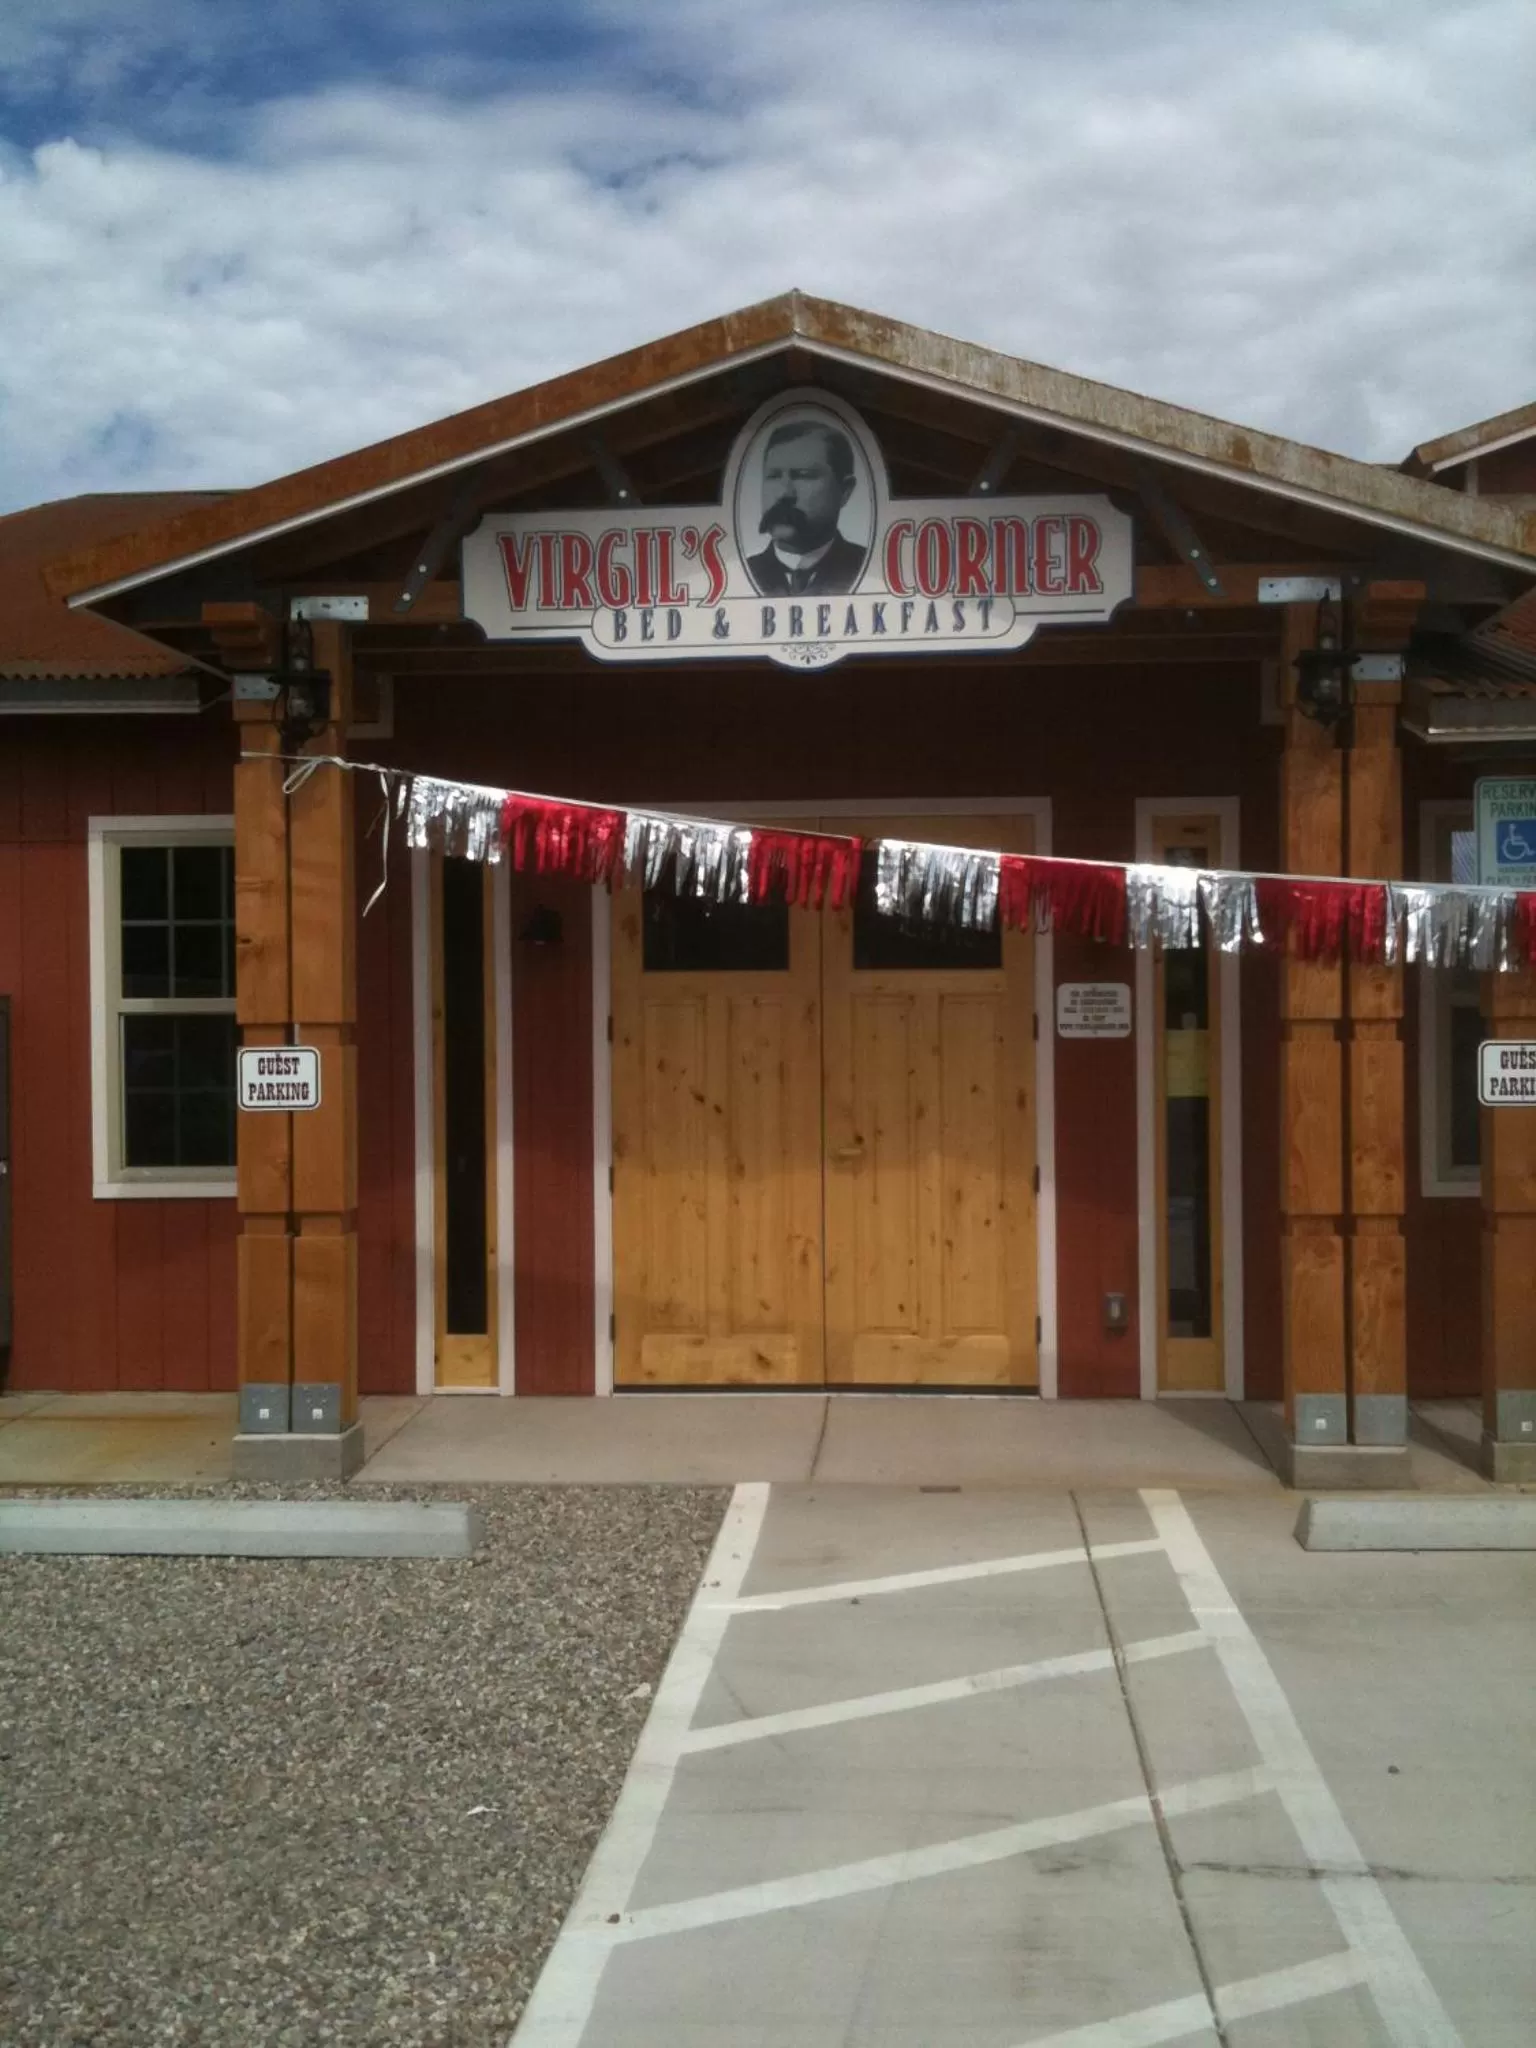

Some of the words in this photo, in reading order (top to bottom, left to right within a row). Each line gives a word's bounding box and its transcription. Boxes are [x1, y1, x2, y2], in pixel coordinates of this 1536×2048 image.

[497, 523, 728, 611] VIRGIL'S
[883, 515, 1104, 598] CORNER
[614, 608, 682, 641] BED
[713, 607, 730, 639] &
[761, 599, 994, 638] BREAKFAST
[257, 1057, 300, 1076] GUEST
[248, 1082, 309, 1101] PARKING
[1489, 1077, 1536, 1096] PARKI
